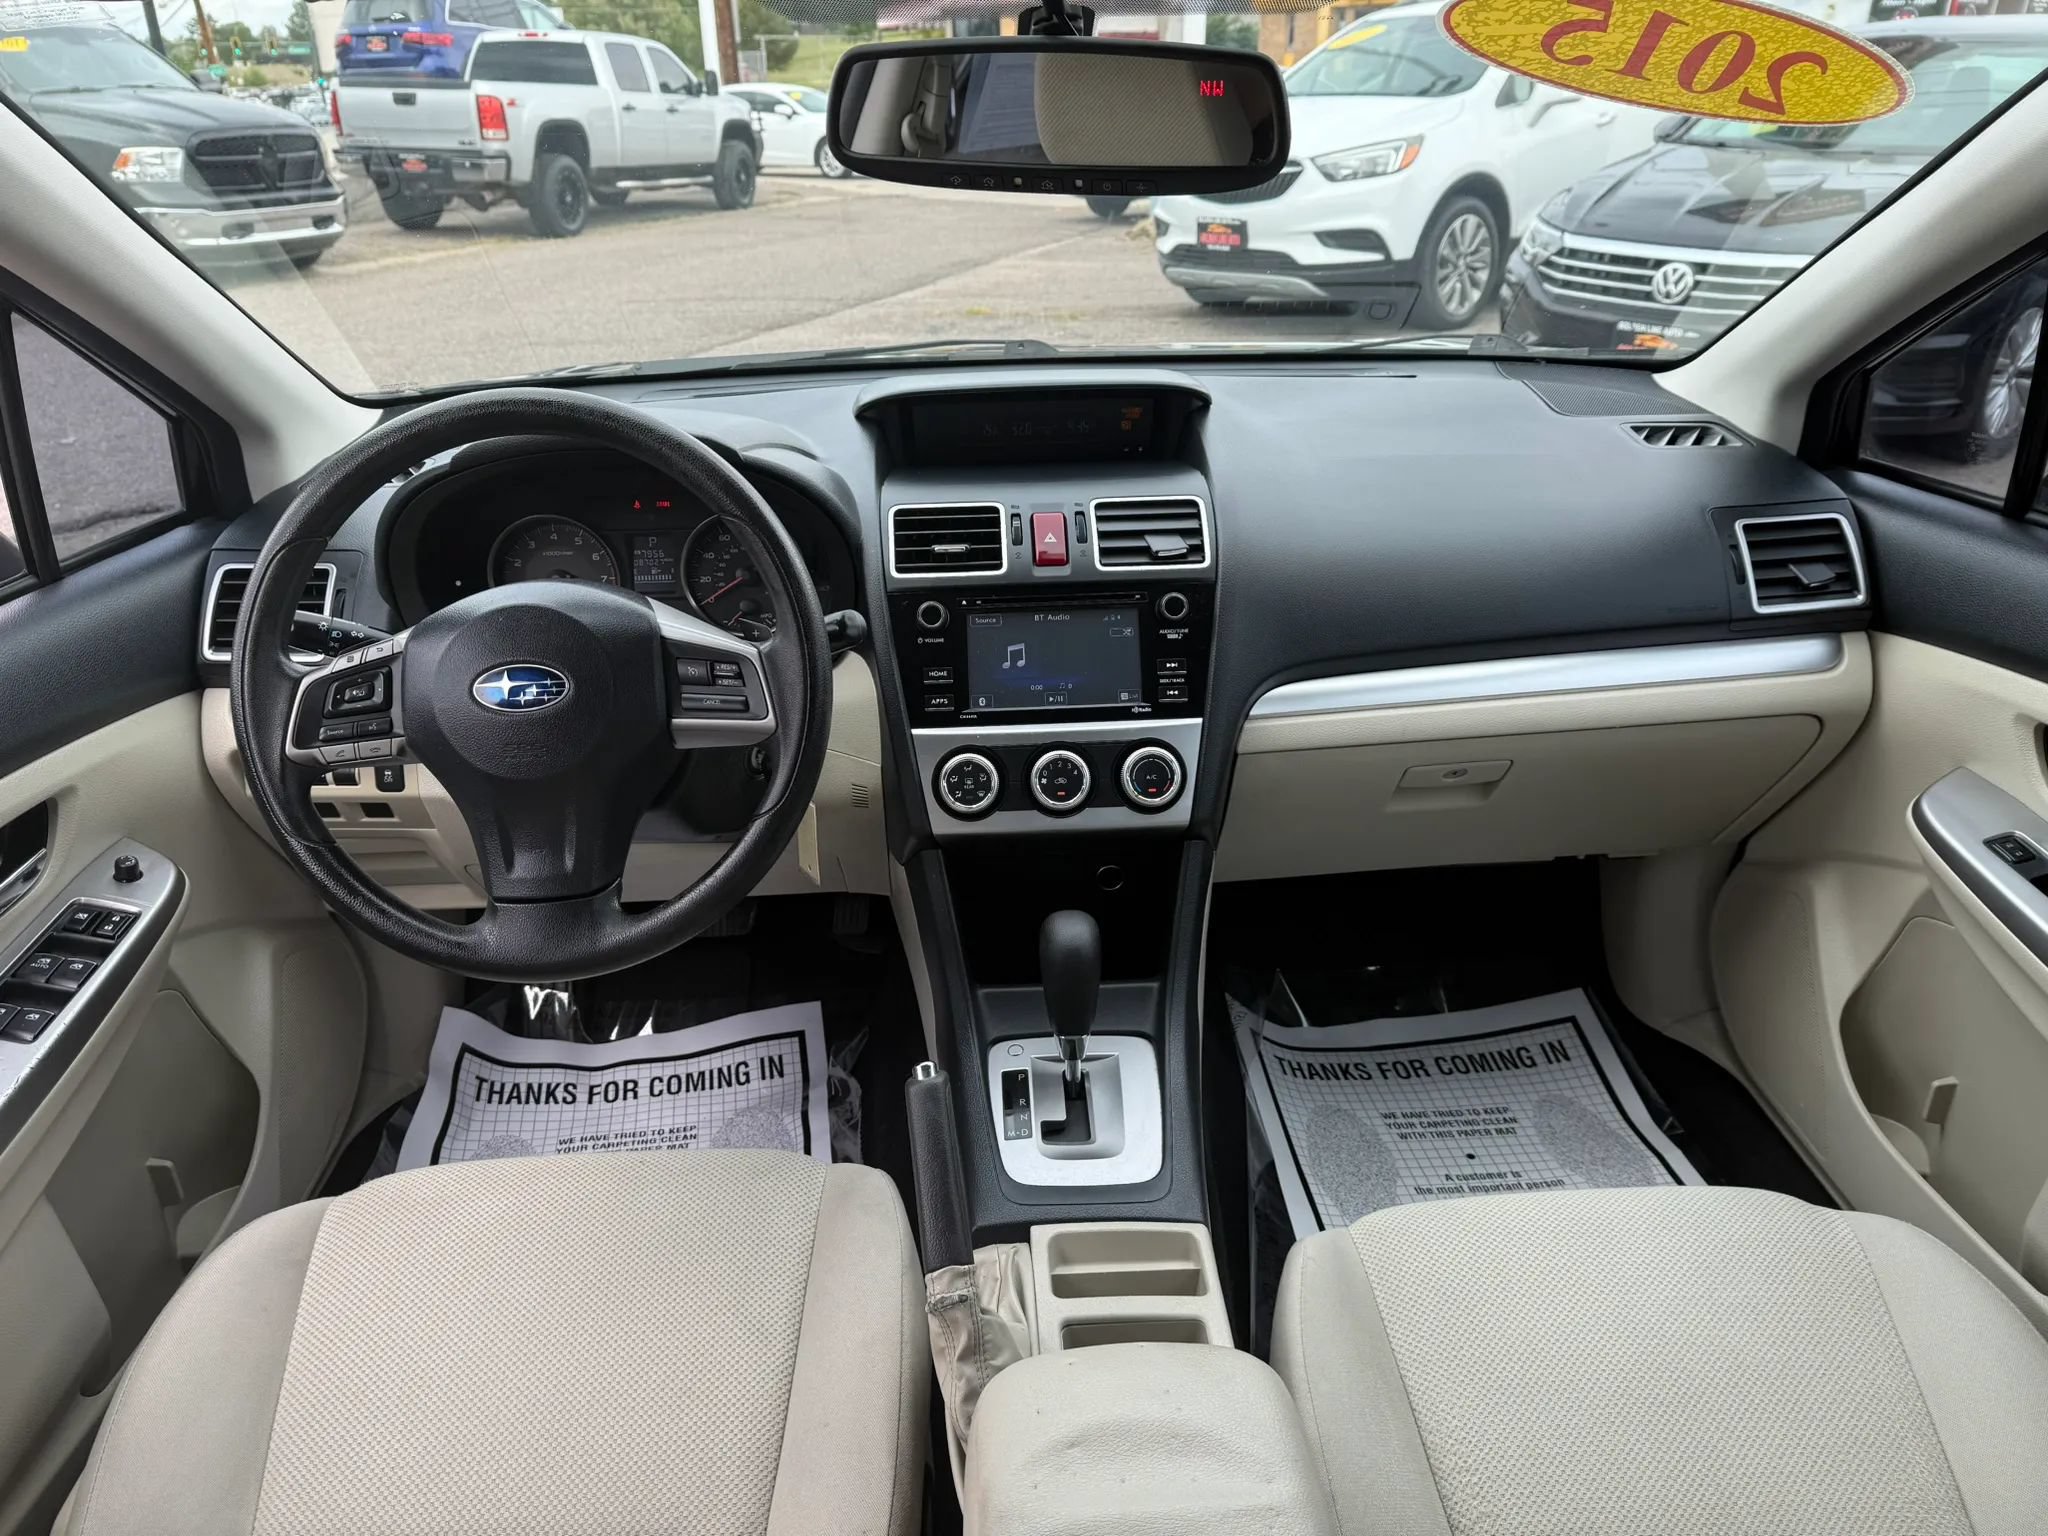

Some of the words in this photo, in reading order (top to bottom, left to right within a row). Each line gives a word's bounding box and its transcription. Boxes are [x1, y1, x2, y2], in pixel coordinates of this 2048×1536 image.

[1200, 80, 1225, 97] NW
[550, 533, 558, 541] 4
[574, 537, 583, 545] 5
[592, 553, 600, 561] 6
[975, 616, 997, 624] Source
[1034, 614, 1045, 622] BT
[1047, 612, 1070, 621] Audio
[1273, 1054, 1373, 1081] THANKS
[1376, 1059, 1431, 1080] FOR
[1434, 1046, 1538, 1076] COMING
[1539, 1039, 1571, 1065] IN
[475, 1075, 578, 1105] THANKS
[587, 1079, 639, 1105] FOR
[650, 1060, 751, 1098] COMING
[760, 1054, 785, 1081] IN
[1018, 1073, 1025, 1081] P
[1019, 1098, 1027, 1106] R
[1020, 1113, 1028, 1121] N
[1380, 1111, 1400, 1120] WE
[1401, 1110, 1430, 1120] HAVE
[1431, 1108, 1464, 1118] TRIED
[1466, 1108, 1481, 1116] TO
[1482, 1106, 1509, 1115] KEEP
[1385, 1121, 1418, 1130] YOUR
[1419, 1118, 1481, 1129] CARPETING
[1482, 1116, 1519, 1126] CLEAN
[558, 1136, 577, 1146] WE
[580, 1133, 609, 1143] HAVE
[613, 1130, 647, 1140] TRIED
[649, 1128, 665, 1137] TO
[668, 1124, 697, 1135] KEEP
[1396, 1131, 1427, 1140] WITH
[1429, 1129, 1455, 1139] THIS
[1456, 1128, 1493, 1138] PAPER
[1495, 1126, 1518, 1136] MAT
[556, 1144, 589, 1154] YOUR
[592, 1137, 657, 1150] CARPETING
[660, 1133, 697, 1144] CLEAN
[667, 1142, 690, 1151] MAT
[1444, 1173, 1454, 1182] A
[1455, 1172, 1509, 1182] customer
[1414, 1186, 1434, 1196] the
[1436, 1184, 1466, 1195] most
[1467, 1180, 1525, 1194] important
[1526, 1178, 1566, 1191] person
